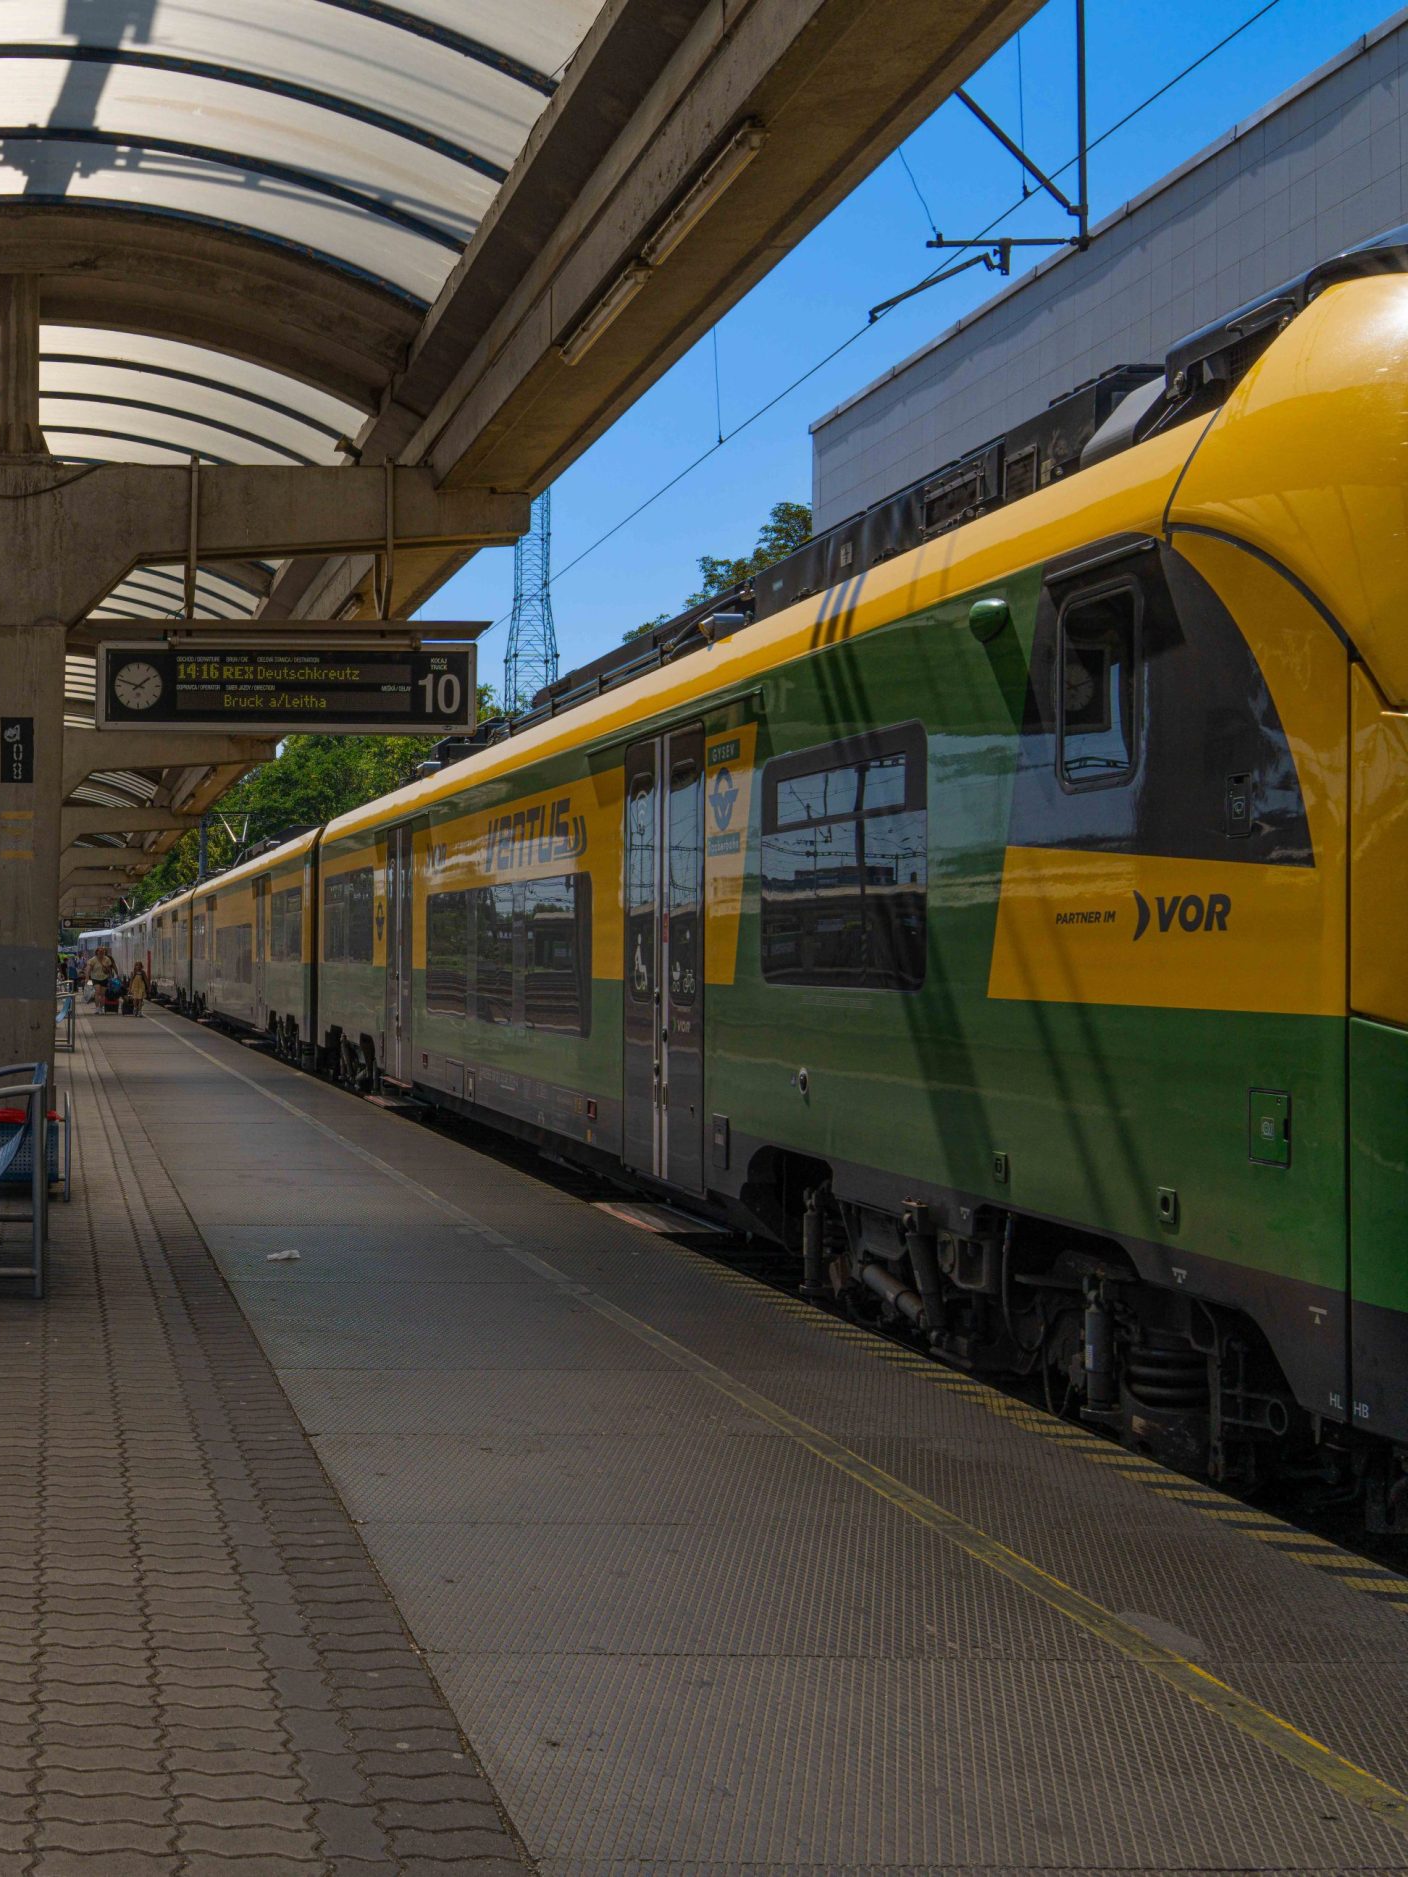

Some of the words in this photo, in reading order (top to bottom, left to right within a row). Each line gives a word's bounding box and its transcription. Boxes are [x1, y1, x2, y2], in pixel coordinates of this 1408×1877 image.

[177, 663, 220, 679] 14:16
[222, 666, 254, 679] REX
[257, 666, 360, 680] Deutschkreutz
[223, 694, 264, 708] Bruck
[268, 693, 327, 708] a/Leitha
[417, 673, 461, 714] 10
[711, 743, 736, 762] GYSEV
[1055, 912, 1102, 925] PARTNER
[1103, 911, 1116, 923] IM
[1154, 893, 1232, 933] VOR
[1329, 1392, 1343, 1410] HL
[1354, 1400, 1369, 1419] HB
